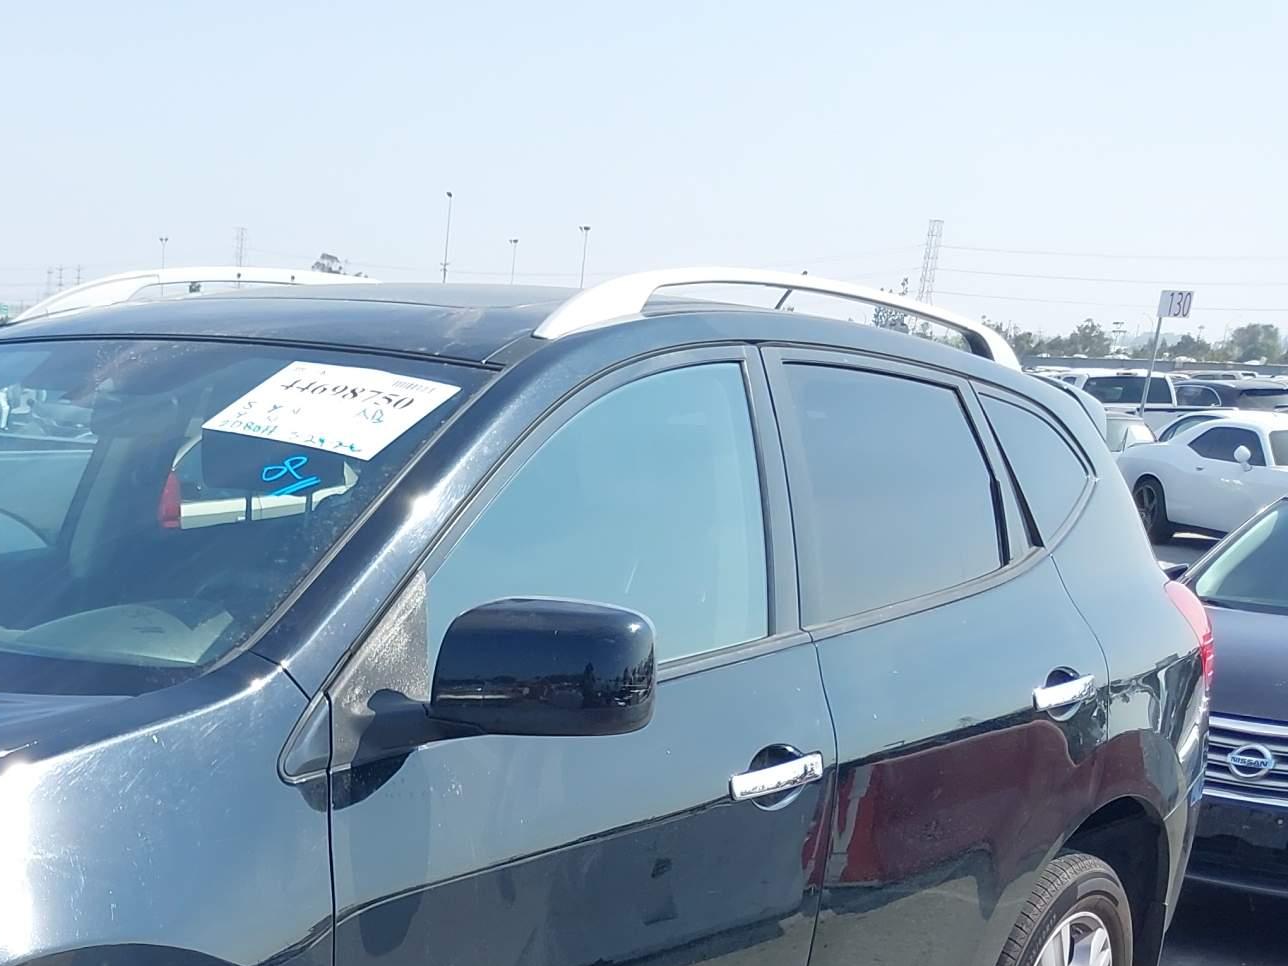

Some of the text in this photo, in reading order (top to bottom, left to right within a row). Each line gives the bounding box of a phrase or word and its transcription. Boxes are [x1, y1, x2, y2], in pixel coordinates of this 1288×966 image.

[1167, 292, 1192, 318] 130
[281, 378, 415, 410] 44698750
[1230, 756, 1269, 768] NISSAN
